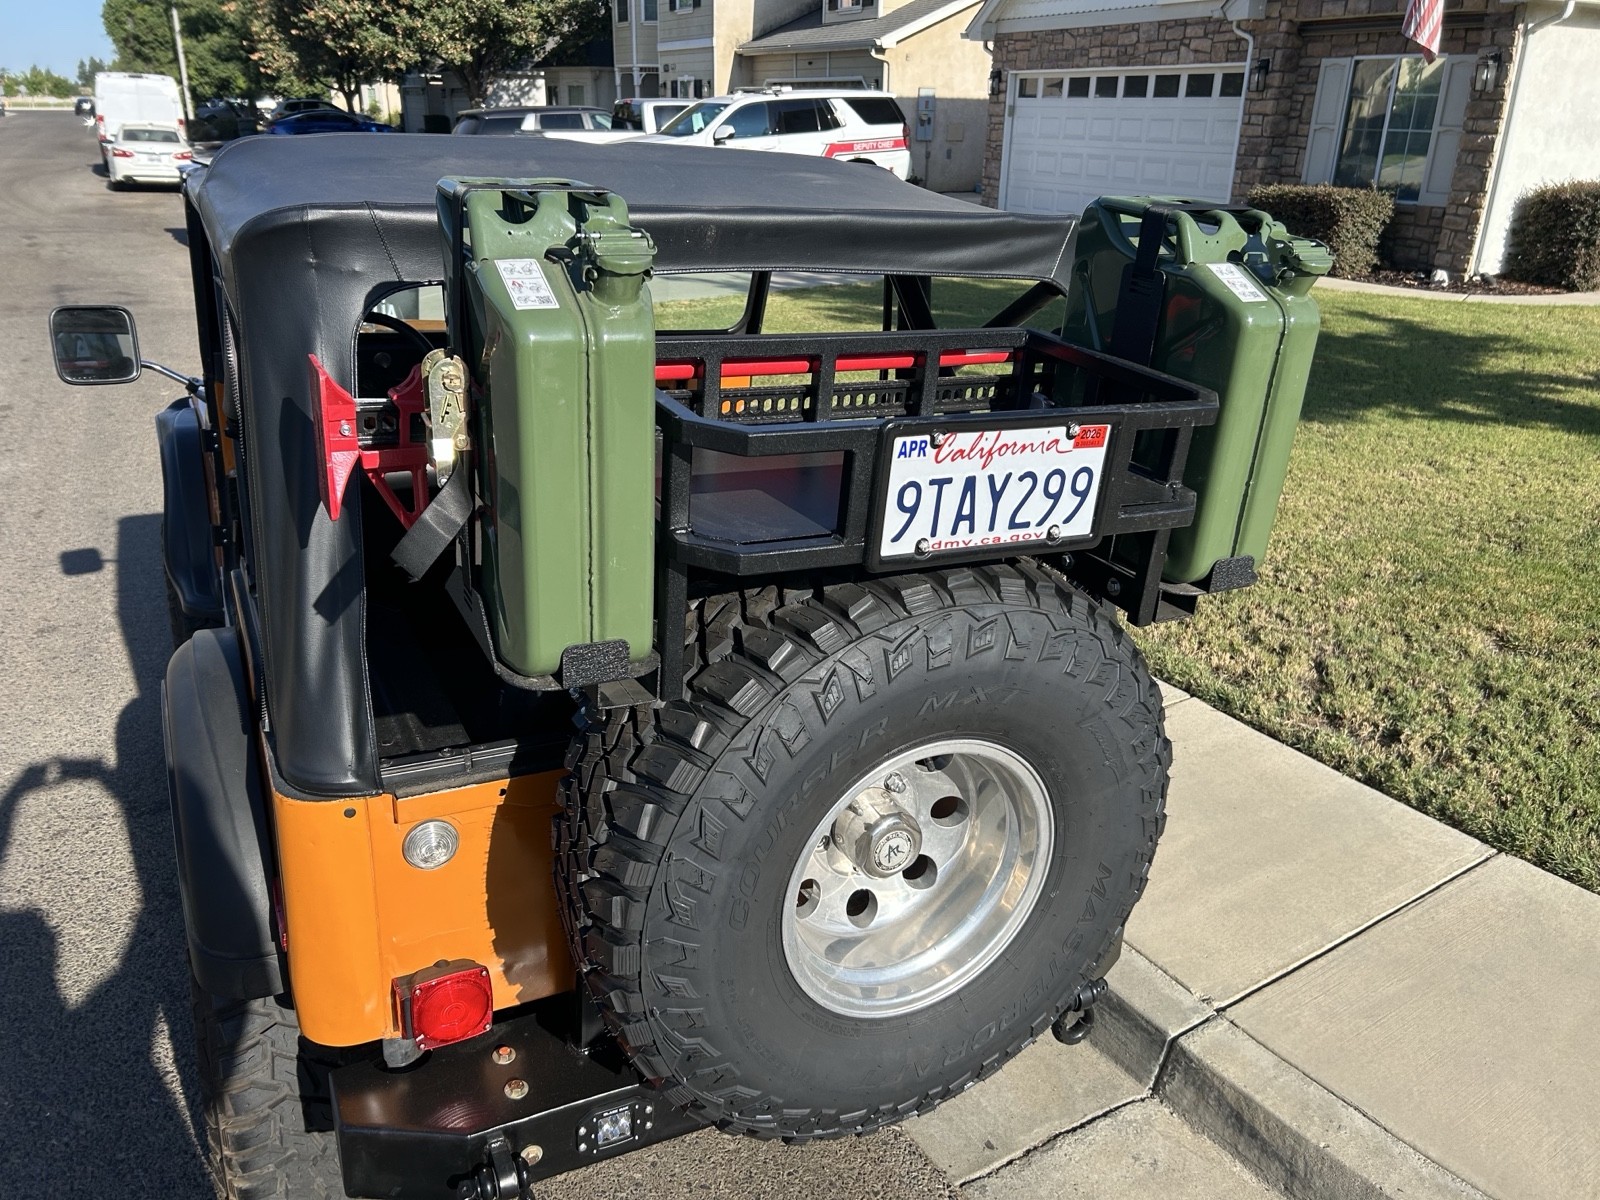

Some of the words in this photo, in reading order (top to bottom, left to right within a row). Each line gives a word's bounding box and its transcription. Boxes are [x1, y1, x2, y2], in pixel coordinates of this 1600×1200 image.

[853, 142, 877, 151] DEPUTY
[878, 140, 895, 148] CHIEF
[1080, 429, 1102, 440] 2026
[897, 440, 927, 459] APR
[934, 431, 1073, 470] California
[890, 466, 1094, 543] 9TAY299
[931, 530, 1044, 551] dmv.ca.gov
[729, 716, 889, 933] COURSER
[915, 685, 1031, 717] MXT
